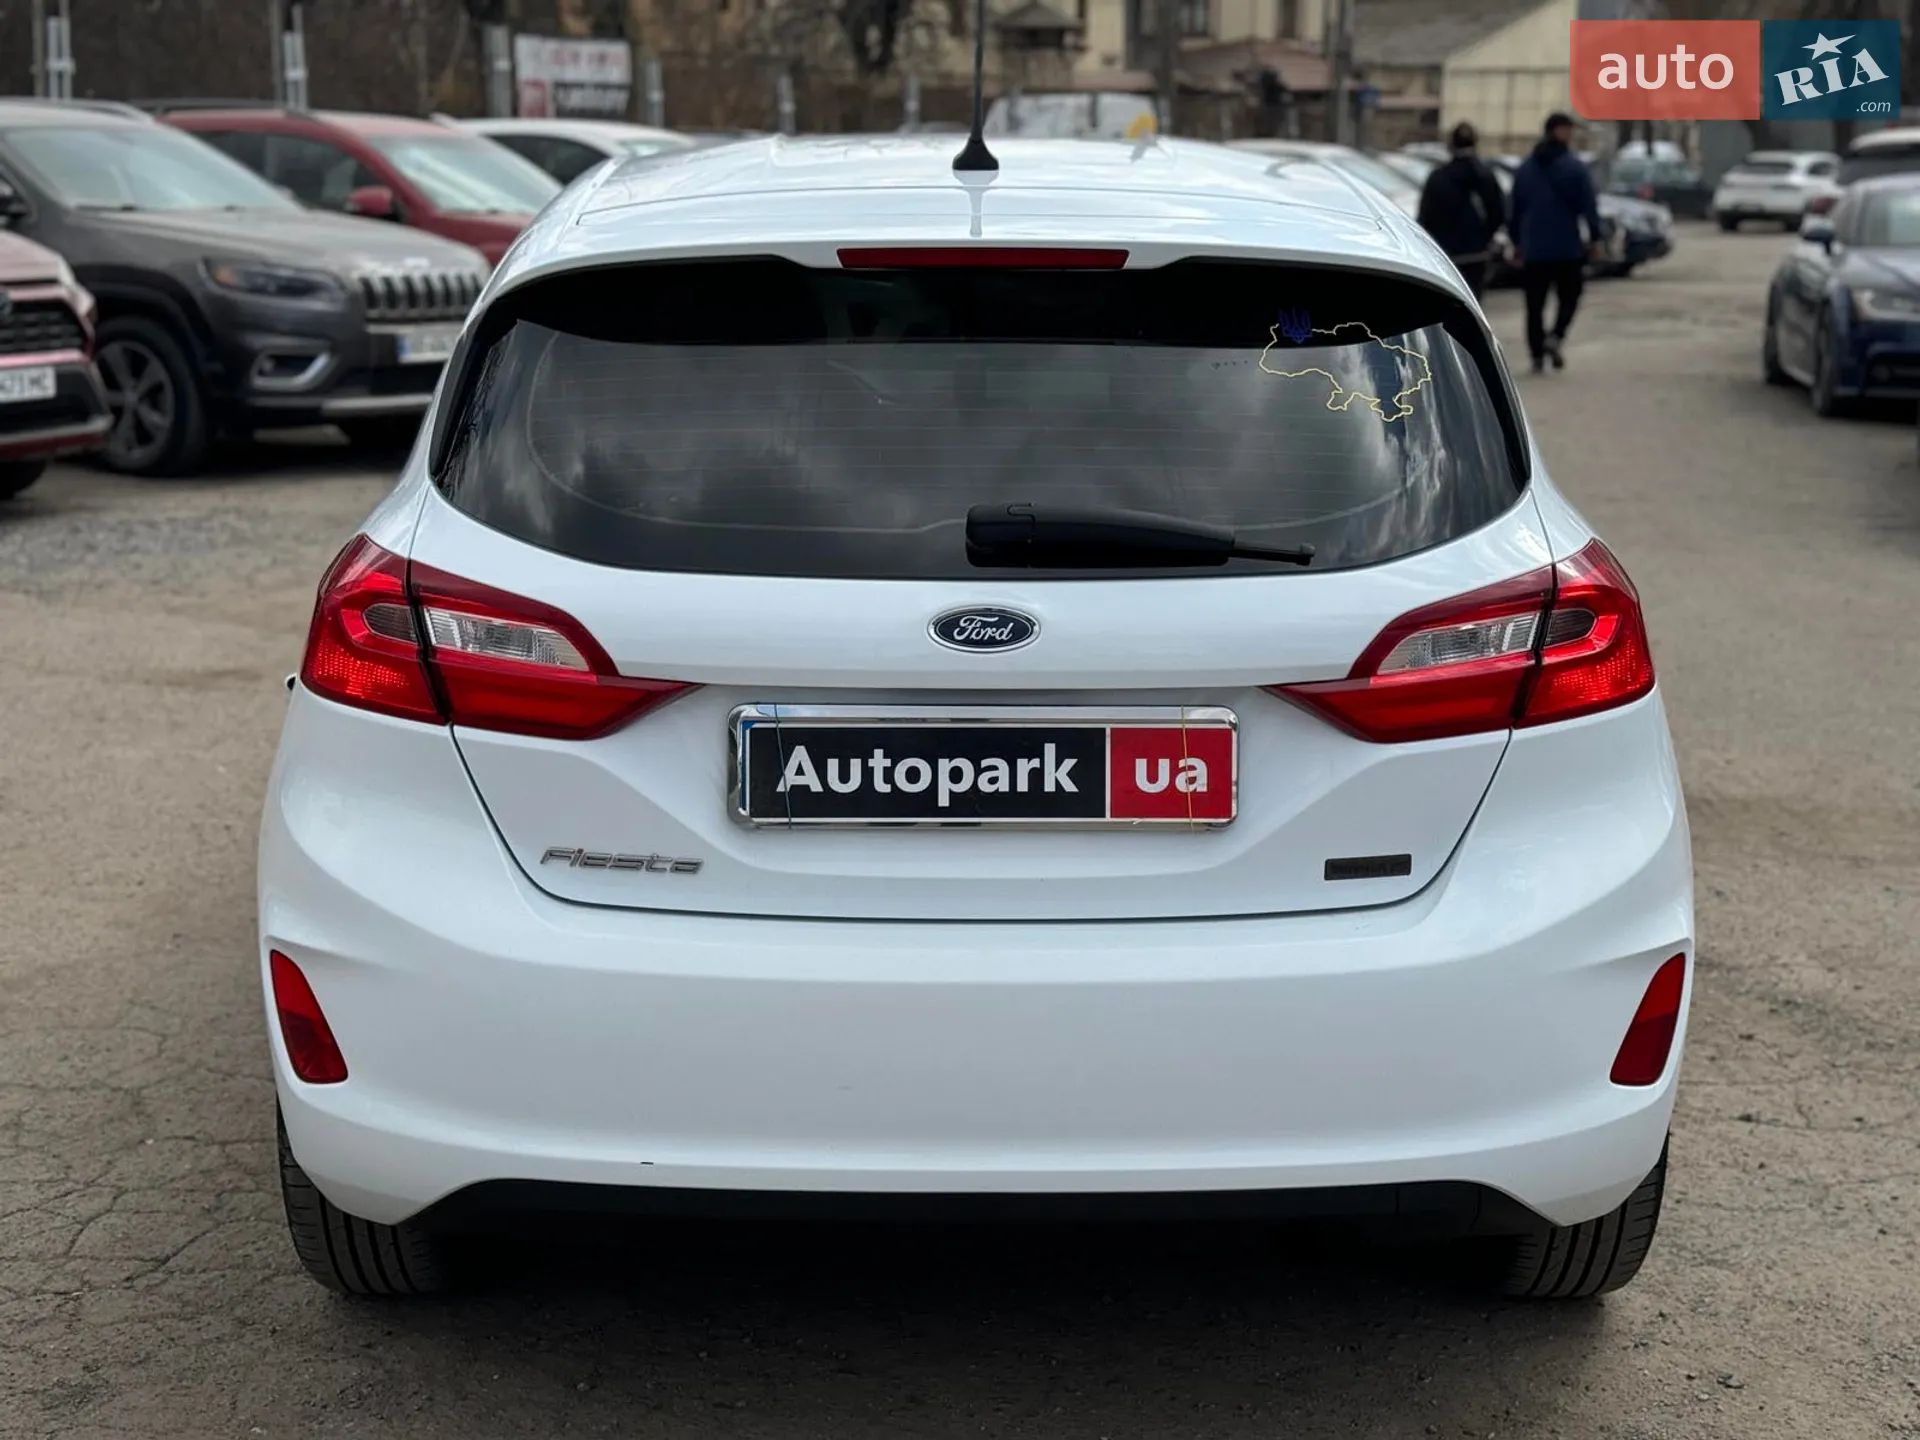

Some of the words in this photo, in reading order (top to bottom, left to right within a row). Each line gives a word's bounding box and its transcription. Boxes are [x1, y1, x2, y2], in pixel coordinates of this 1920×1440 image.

[953, 615, 1014, 641] Ford
[775, 742, 1079, 808] Autopark
[1134, 756, 1208, 793] ua
[539, 846, 703, 875] Fiesta
